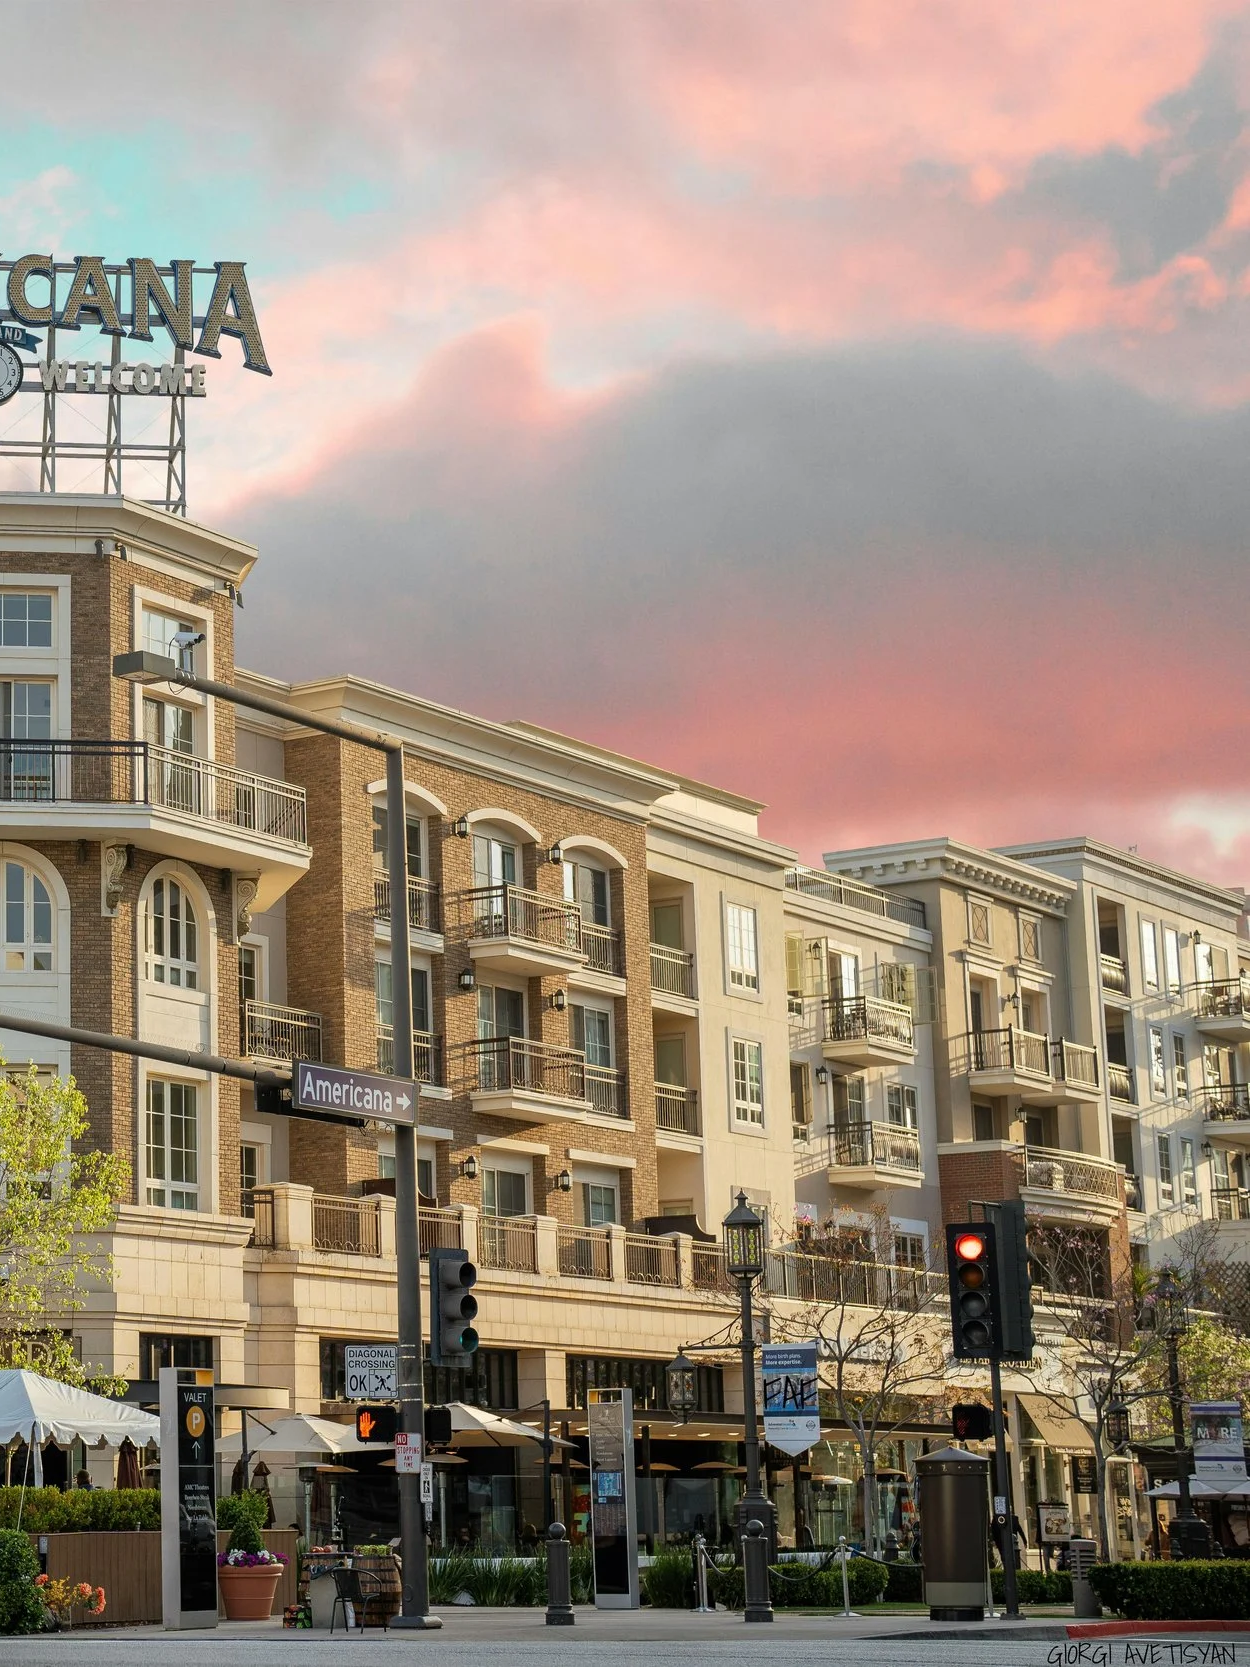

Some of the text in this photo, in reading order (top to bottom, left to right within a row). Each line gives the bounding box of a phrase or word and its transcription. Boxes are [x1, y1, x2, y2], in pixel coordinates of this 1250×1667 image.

[12, 368, 16, 376] 3
[38, 359, 206, 397] WELCOME
[302, 1071, 392, 1112] Americana
[348, 1350, 394, 1358] DIAGONAL
[348, 1360, 395, 1368] CROSSING
[350, 1374, 367, 1392] OK
[184, 1392, 206, 1403] VALET
[192, 1412, 200, 1430] P
[1197, 1427, 1238, 1439] MRE
[396, 1434, 407, 1444] NO
[397, 1446, 420, 1454] STOPPING
